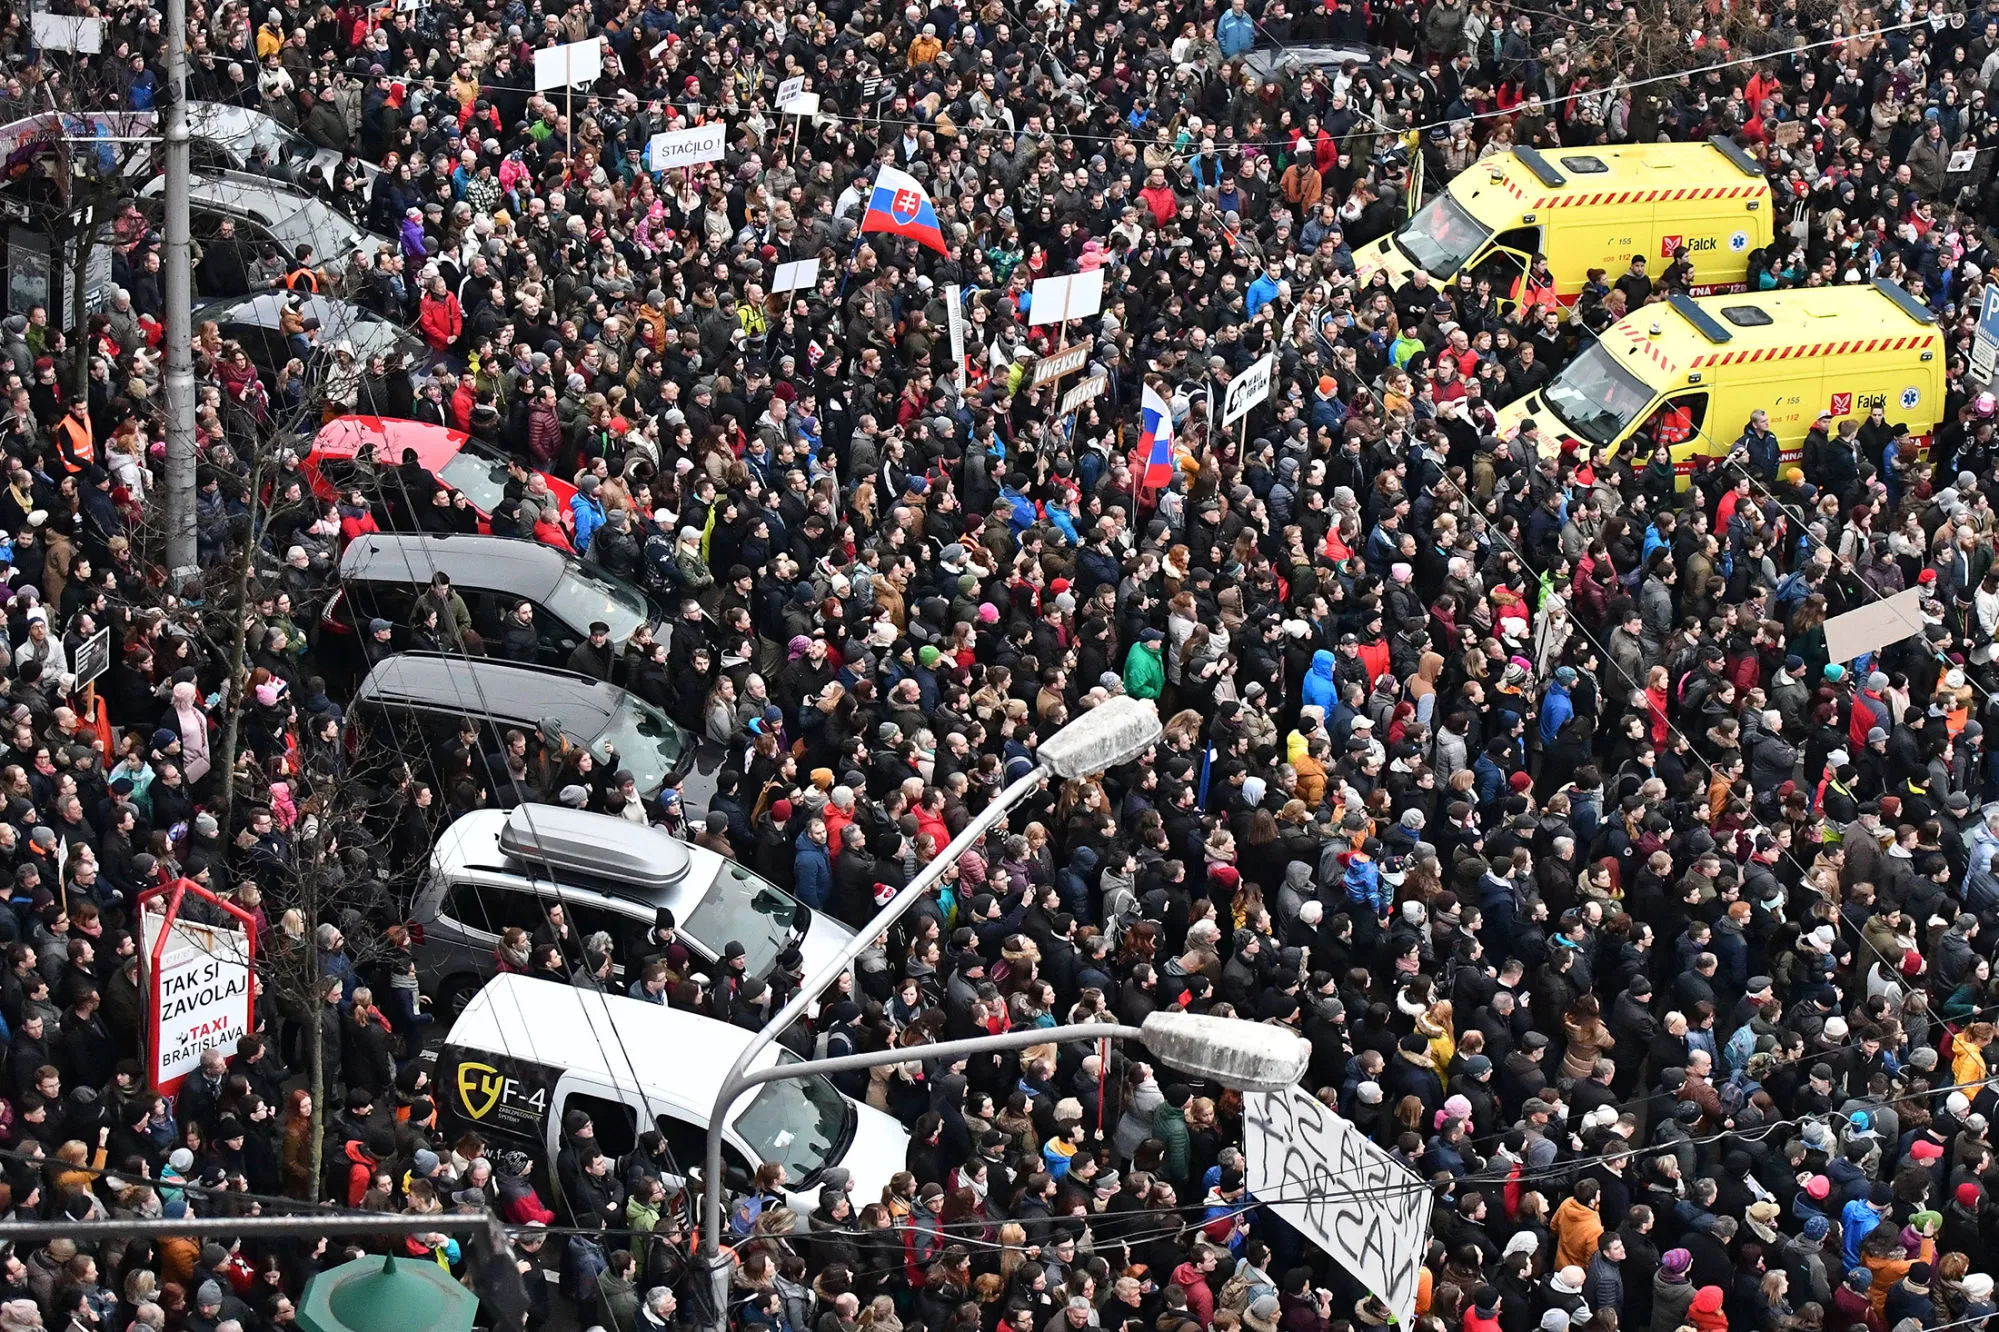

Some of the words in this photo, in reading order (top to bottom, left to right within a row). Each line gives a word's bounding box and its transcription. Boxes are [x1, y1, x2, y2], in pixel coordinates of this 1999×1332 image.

[662, 140, 713, 157] STAČILO
[1619, 237, 1632, 245] 155
[1687, 237, 1717, 251] Falck
[1619, 253, 1631, 261] 112
[1787, 396, 1800, 405] 155
[1857, 393, 1887, 409] Falck
[1786, 413, 1799, 422] 112
[162, 969, 199, 997] TAK
[204, 962, 219, 982] SI
[162, 975, 246, 1022] ZAVOLAJ
[190, 1016, 228, 1040] TAXI
[163, 1026, 244, 1067] BRATISLAVA
[502, 1078, 546, 1113] F-4
